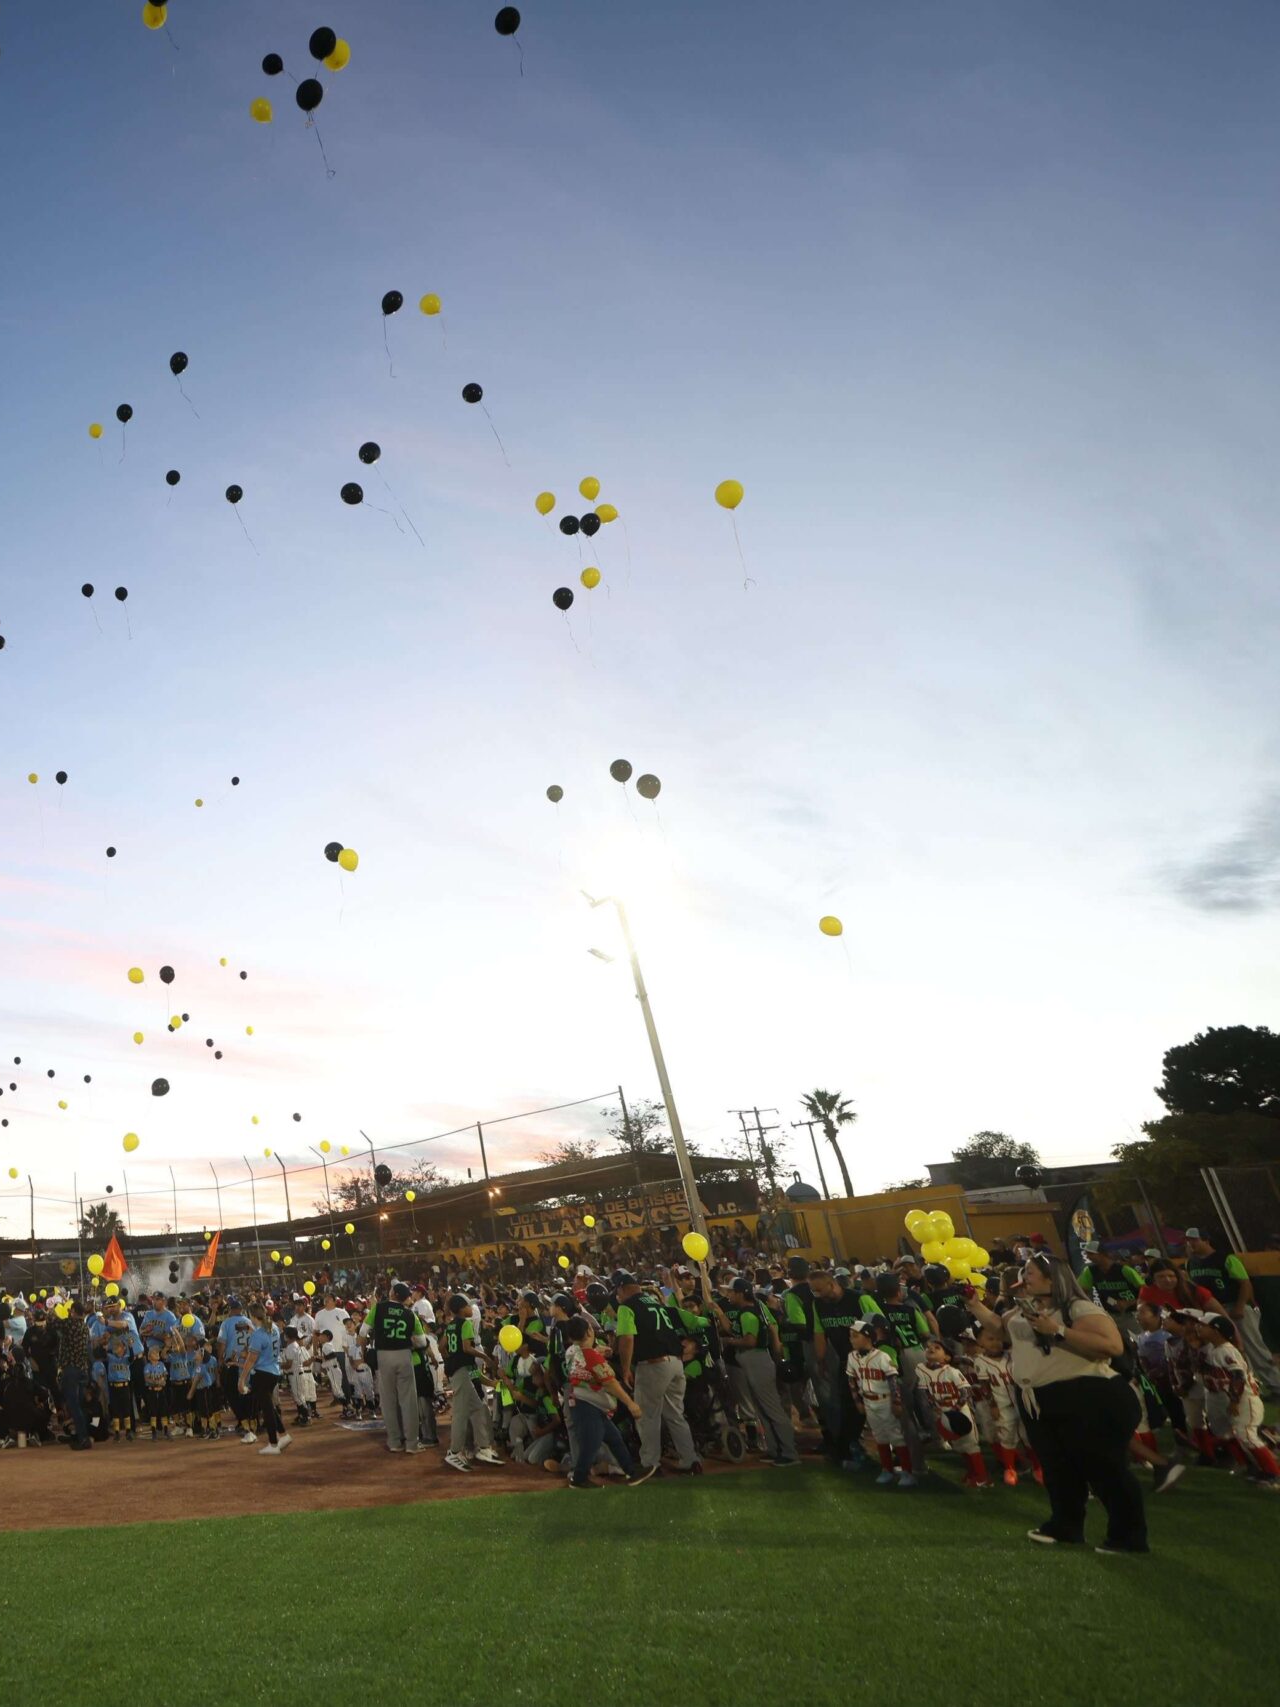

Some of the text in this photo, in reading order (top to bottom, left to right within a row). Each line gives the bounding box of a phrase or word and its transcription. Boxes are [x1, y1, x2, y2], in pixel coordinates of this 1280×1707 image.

[605, 1199, 626, 1214] DE
[383, 1318, 407, 1340] 52
[647, 1307, 675, 1332] 76
[895, 1324, 919, 1347] 15
